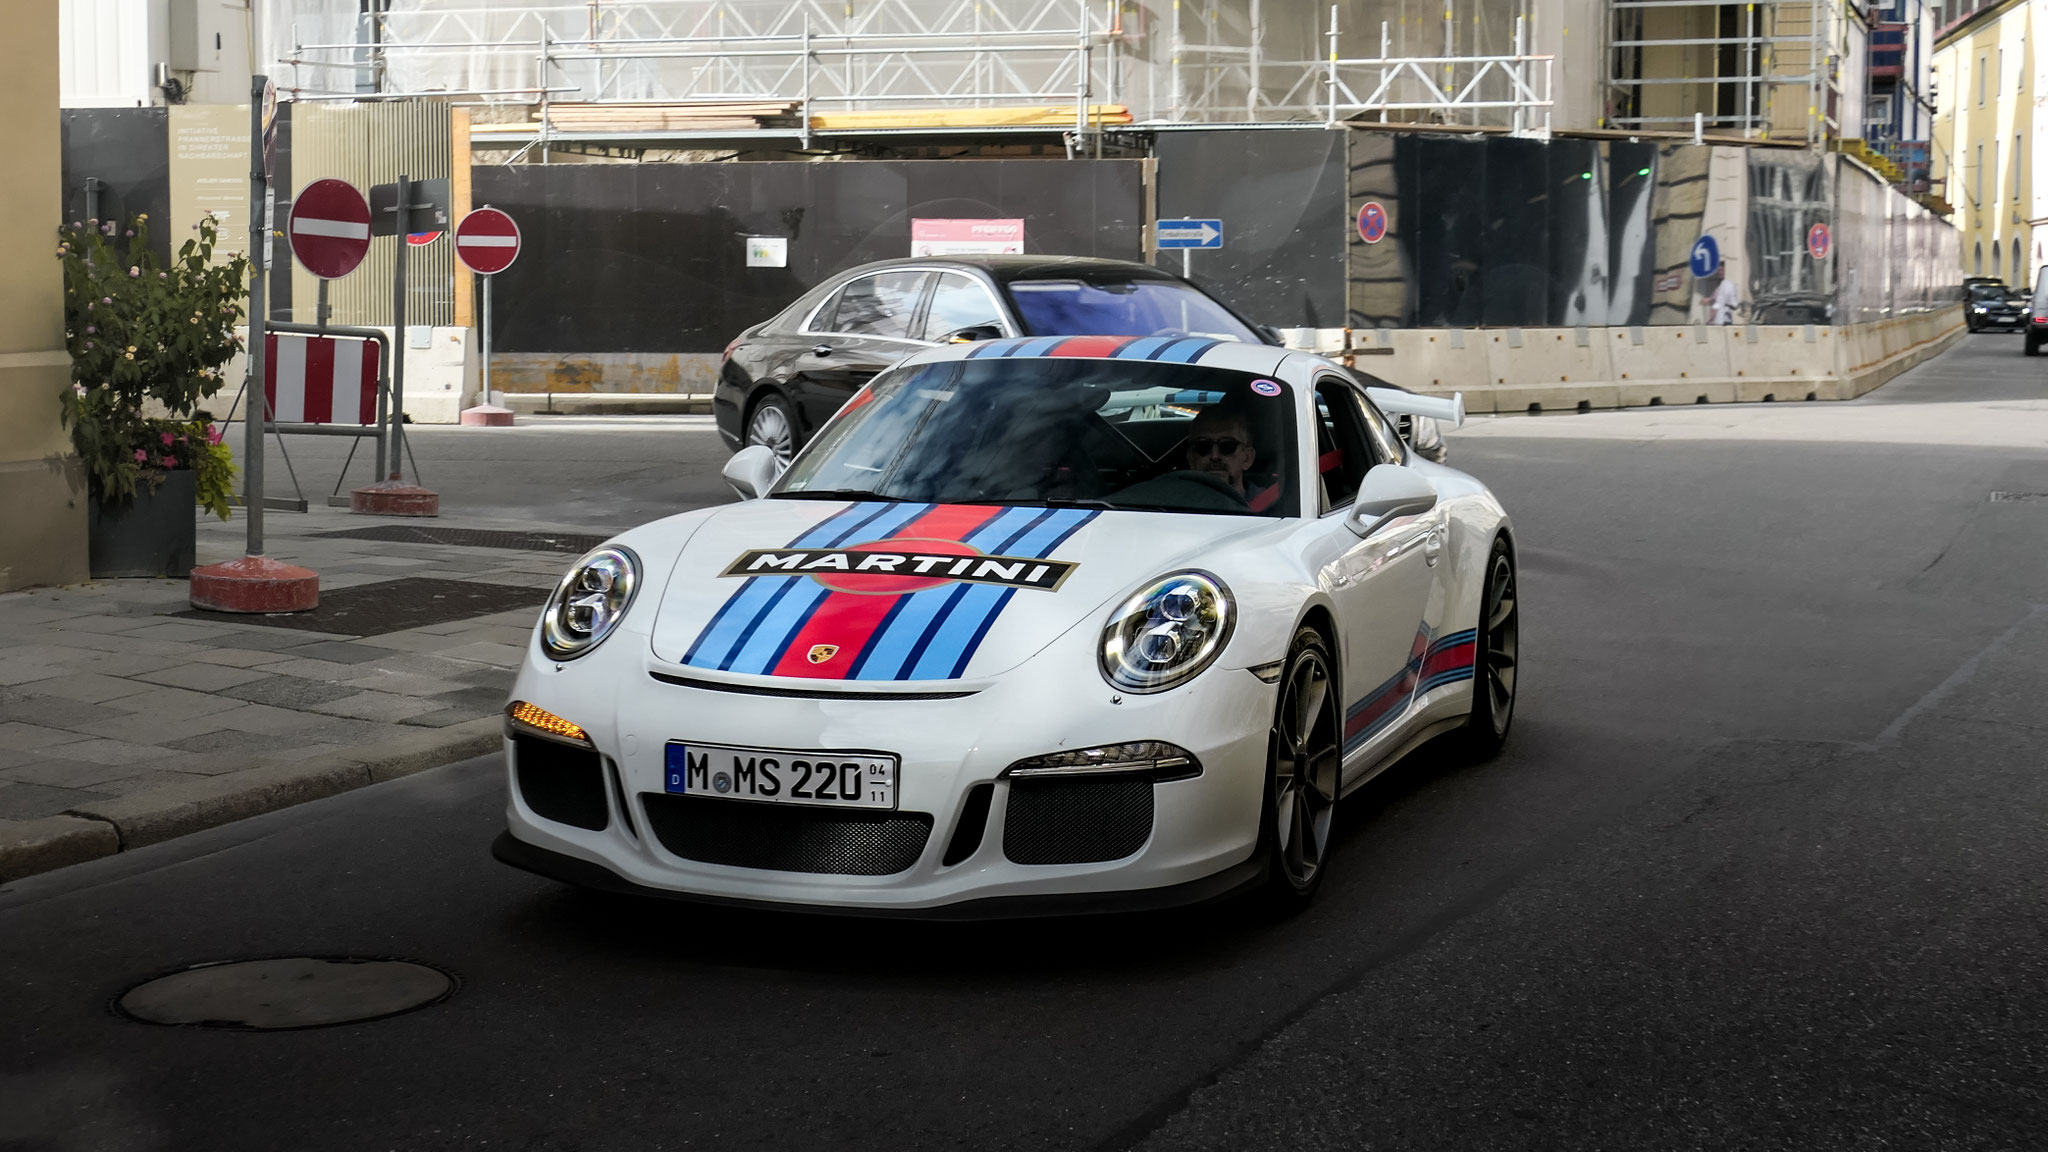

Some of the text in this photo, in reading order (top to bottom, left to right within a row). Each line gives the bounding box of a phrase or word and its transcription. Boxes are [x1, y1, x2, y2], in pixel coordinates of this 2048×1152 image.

[177, 127, 218, 135] INITIATIVE
[747, 553, 1050, 583] MARTINI
[870, 764, 885, 775] 04
[671, 774, 680, 785] D
[687, 752, 862, 800] M MS 220
[871, 791, 885, 802] 11
